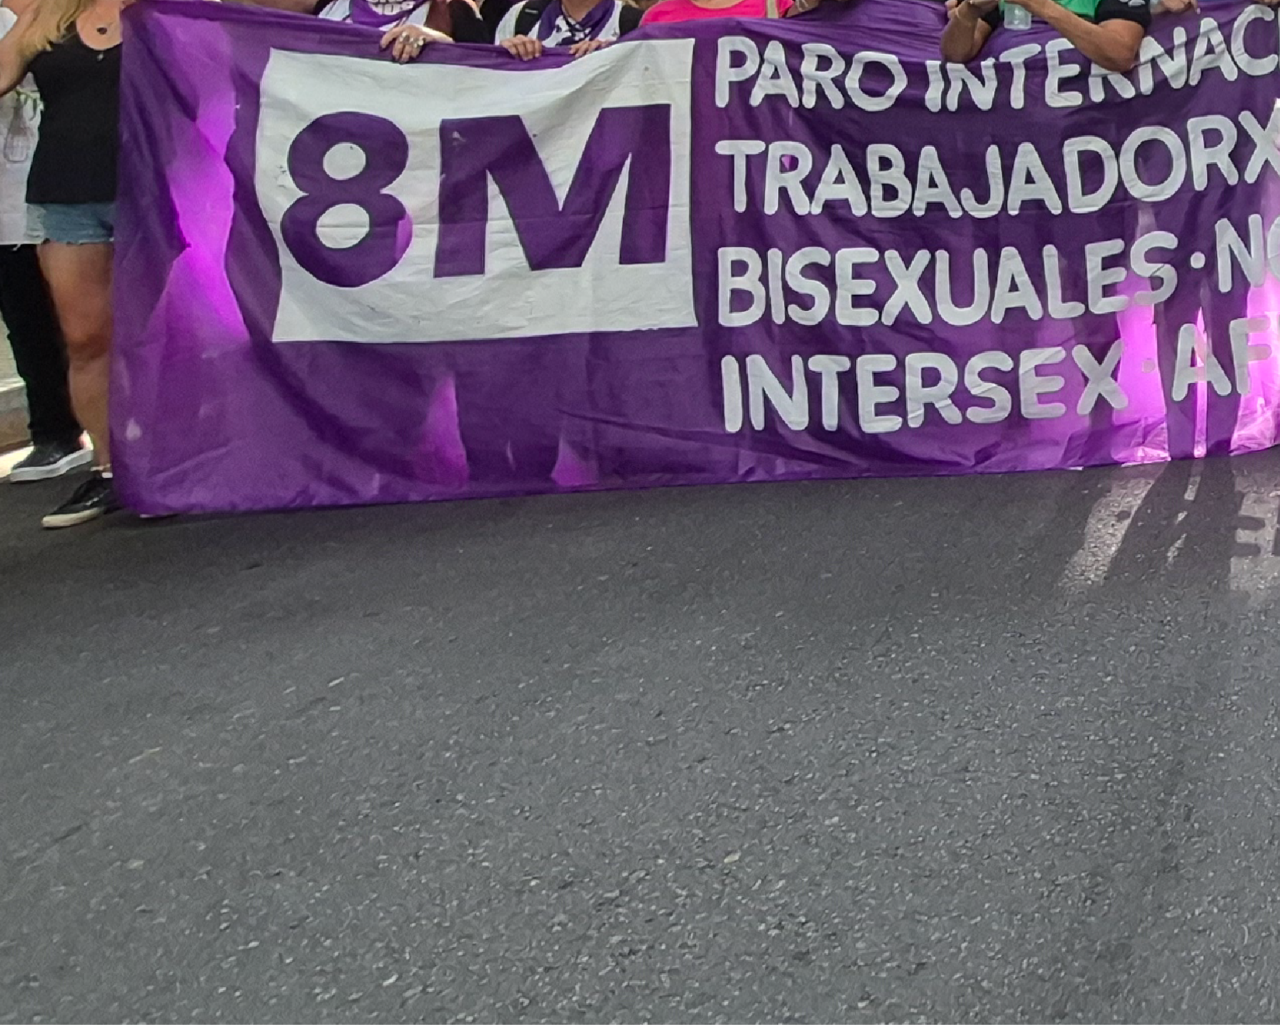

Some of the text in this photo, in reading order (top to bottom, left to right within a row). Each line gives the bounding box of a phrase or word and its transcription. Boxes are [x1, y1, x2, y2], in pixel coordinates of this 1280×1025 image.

[714, 35, 908, 112] PARO
[280, 103, 673, 288] 8M
[717, 230, 1179, 328] BISEXUALES
[721, 339, 1129, 434] INTERSEX
